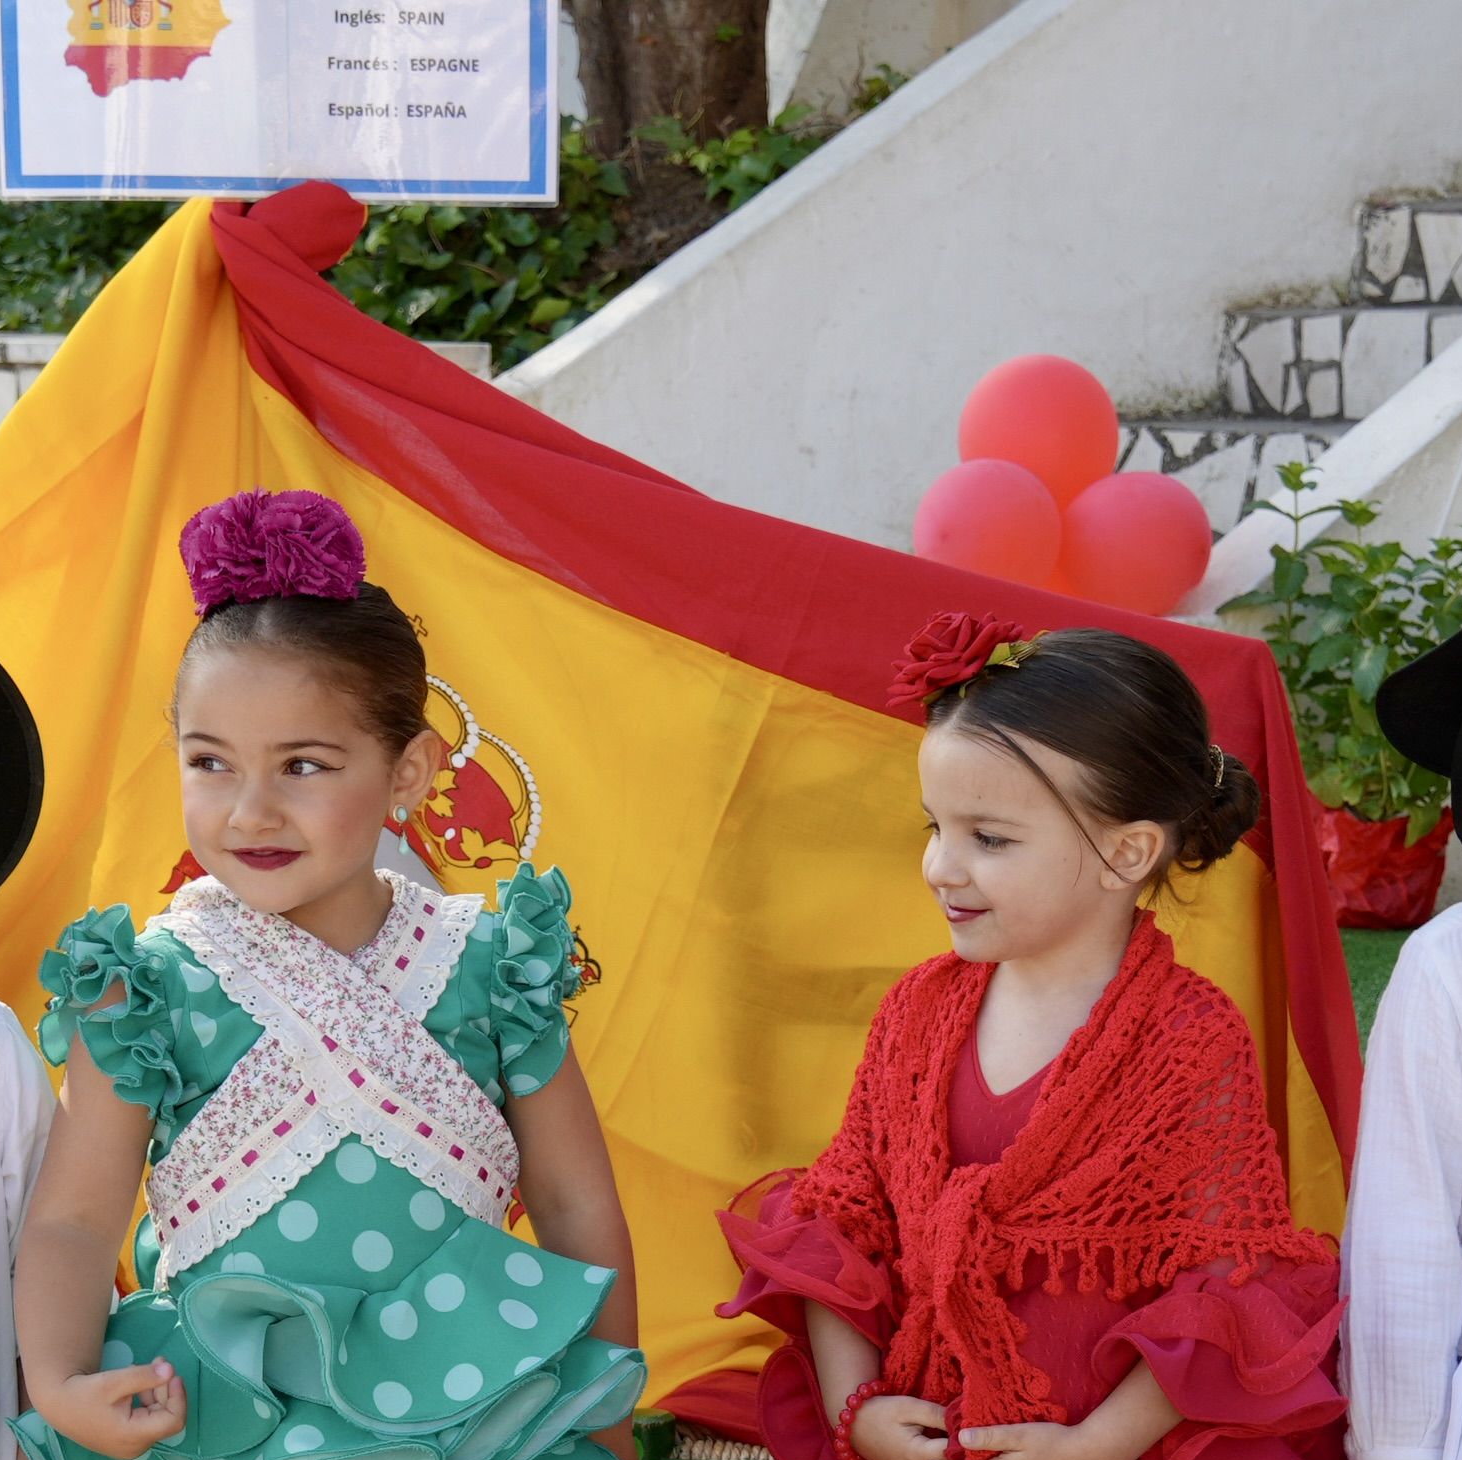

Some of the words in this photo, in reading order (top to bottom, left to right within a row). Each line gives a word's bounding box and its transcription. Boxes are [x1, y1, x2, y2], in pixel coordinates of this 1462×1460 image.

[334, 10, 385, 27] Inglés:
[398, 11, 445, 26] SPAIN
[410, 58, 480, 72] ESPAGNE
[407, 102, 467, 118] ESPAÑA
